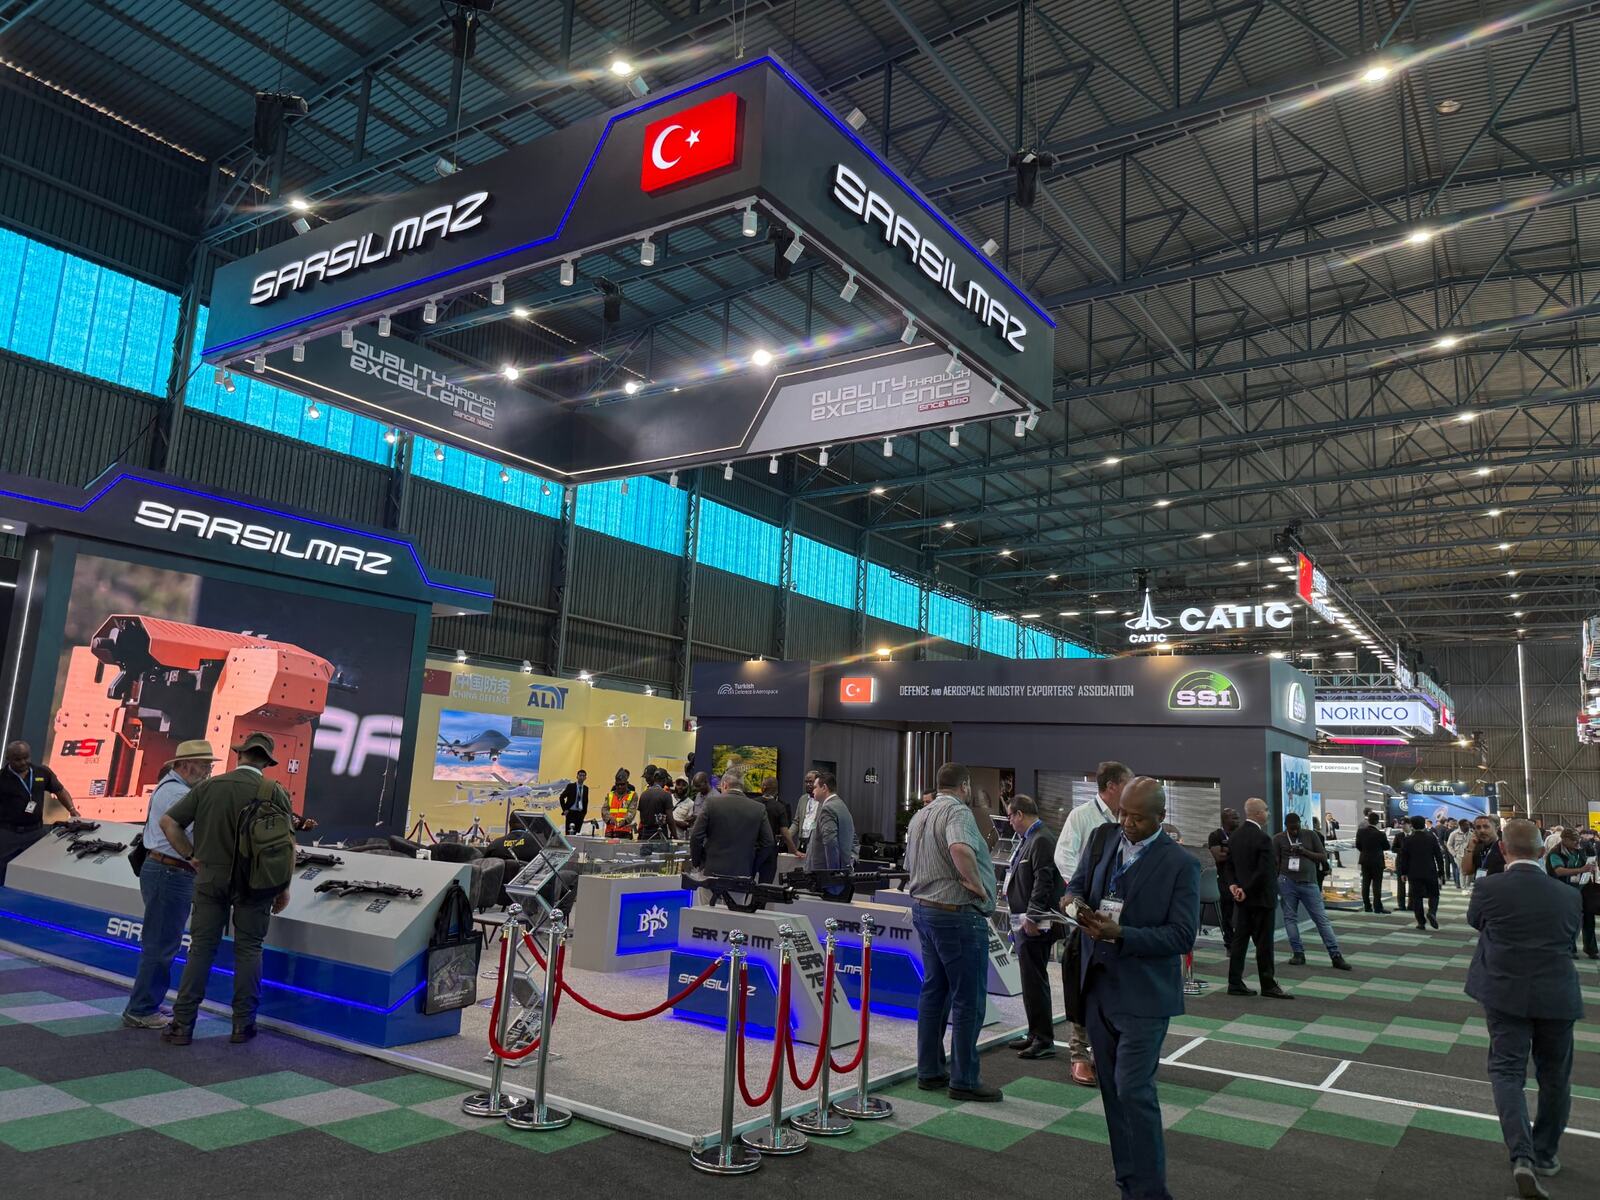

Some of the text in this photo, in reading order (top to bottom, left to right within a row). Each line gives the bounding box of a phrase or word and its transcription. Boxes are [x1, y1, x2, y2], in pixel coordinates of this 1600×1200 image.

[249, 191, 490, 305] SARSILMAZ
[834, 163, 1027, 353] SARSILMAZ
[134, 500, 393, 575] SARSILMAZ
[1179, 604, 1294, 632] CATIC
[1129, 633, 1168, 643] CATIC
[899, 685, 930, 697] DEFENCE
[943, 685, 986, 697] AEROSPACE
[987, 685, 1025, 697] INDUSTRY
[1077, 685, 1134, 697] ASSOCIATION
[1176, 690, 1231, 706] SSI
[1320, 706, 1409, 721] NORINCO
[60, 738, 105, 758] BEST
[1423, 785, 1455, 793] BERETTA
[691, 926, 719, 942] SAR
